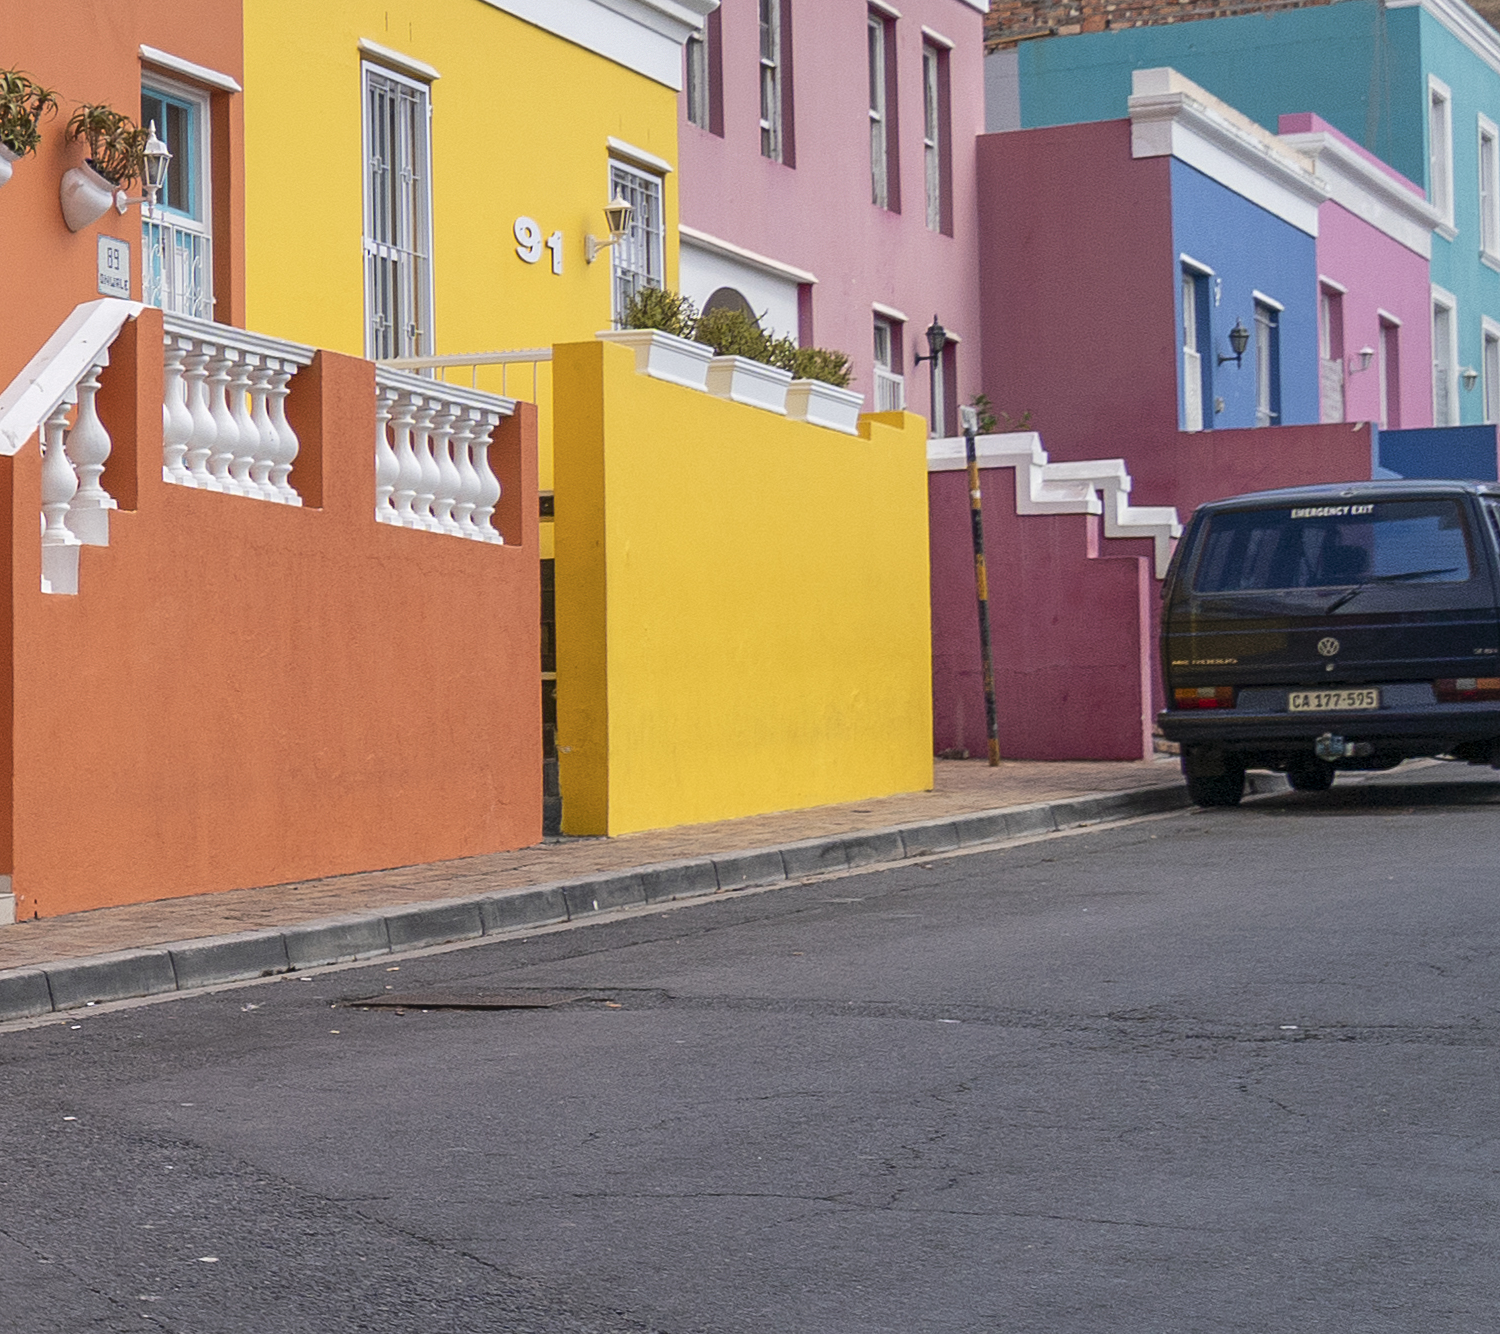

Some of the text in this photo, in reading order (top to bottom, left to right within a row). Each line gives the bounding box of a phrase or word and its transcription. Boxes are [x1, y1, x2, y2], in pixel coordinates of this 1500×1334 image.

[513, 216, 562, 276] 91
[1290, 504, 1375, 519] EMERGENCY EXIT
[1292, 691, 1374, 709] CA 177-595
